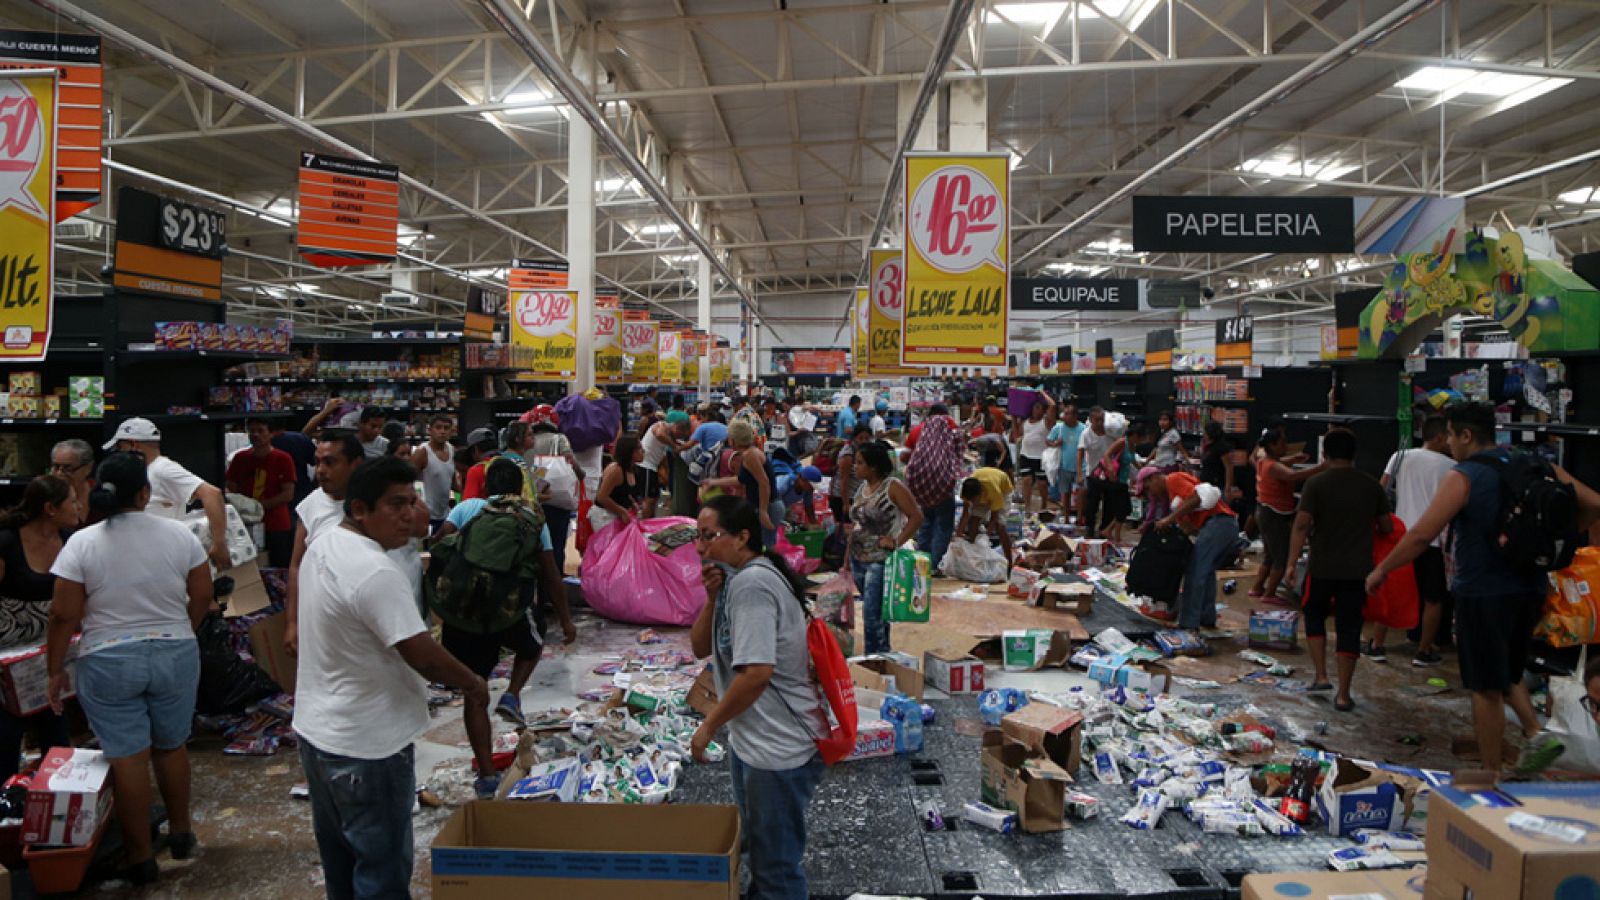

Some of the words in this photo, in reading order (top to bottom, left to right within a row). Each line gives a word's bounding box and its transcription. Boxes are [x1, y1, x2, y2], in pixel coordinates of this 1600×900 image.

[18, 42, 59, 52] CUESTA
[303, 153, 316, 167] 7
[332, 190, 365, 200] CEREALES
[331, 201, 364, 213] GALLETAS
[1166, 212, 1322, 237] PAPELERIA
[138, 278, 172, 293] cuesta
[172, 284, 205, 297] menos
[1032, 286, 1120, 304] EQUIPAJE
[907, 286, 958, 318] LECHE
[958, 285, 1003, 317] LALA
